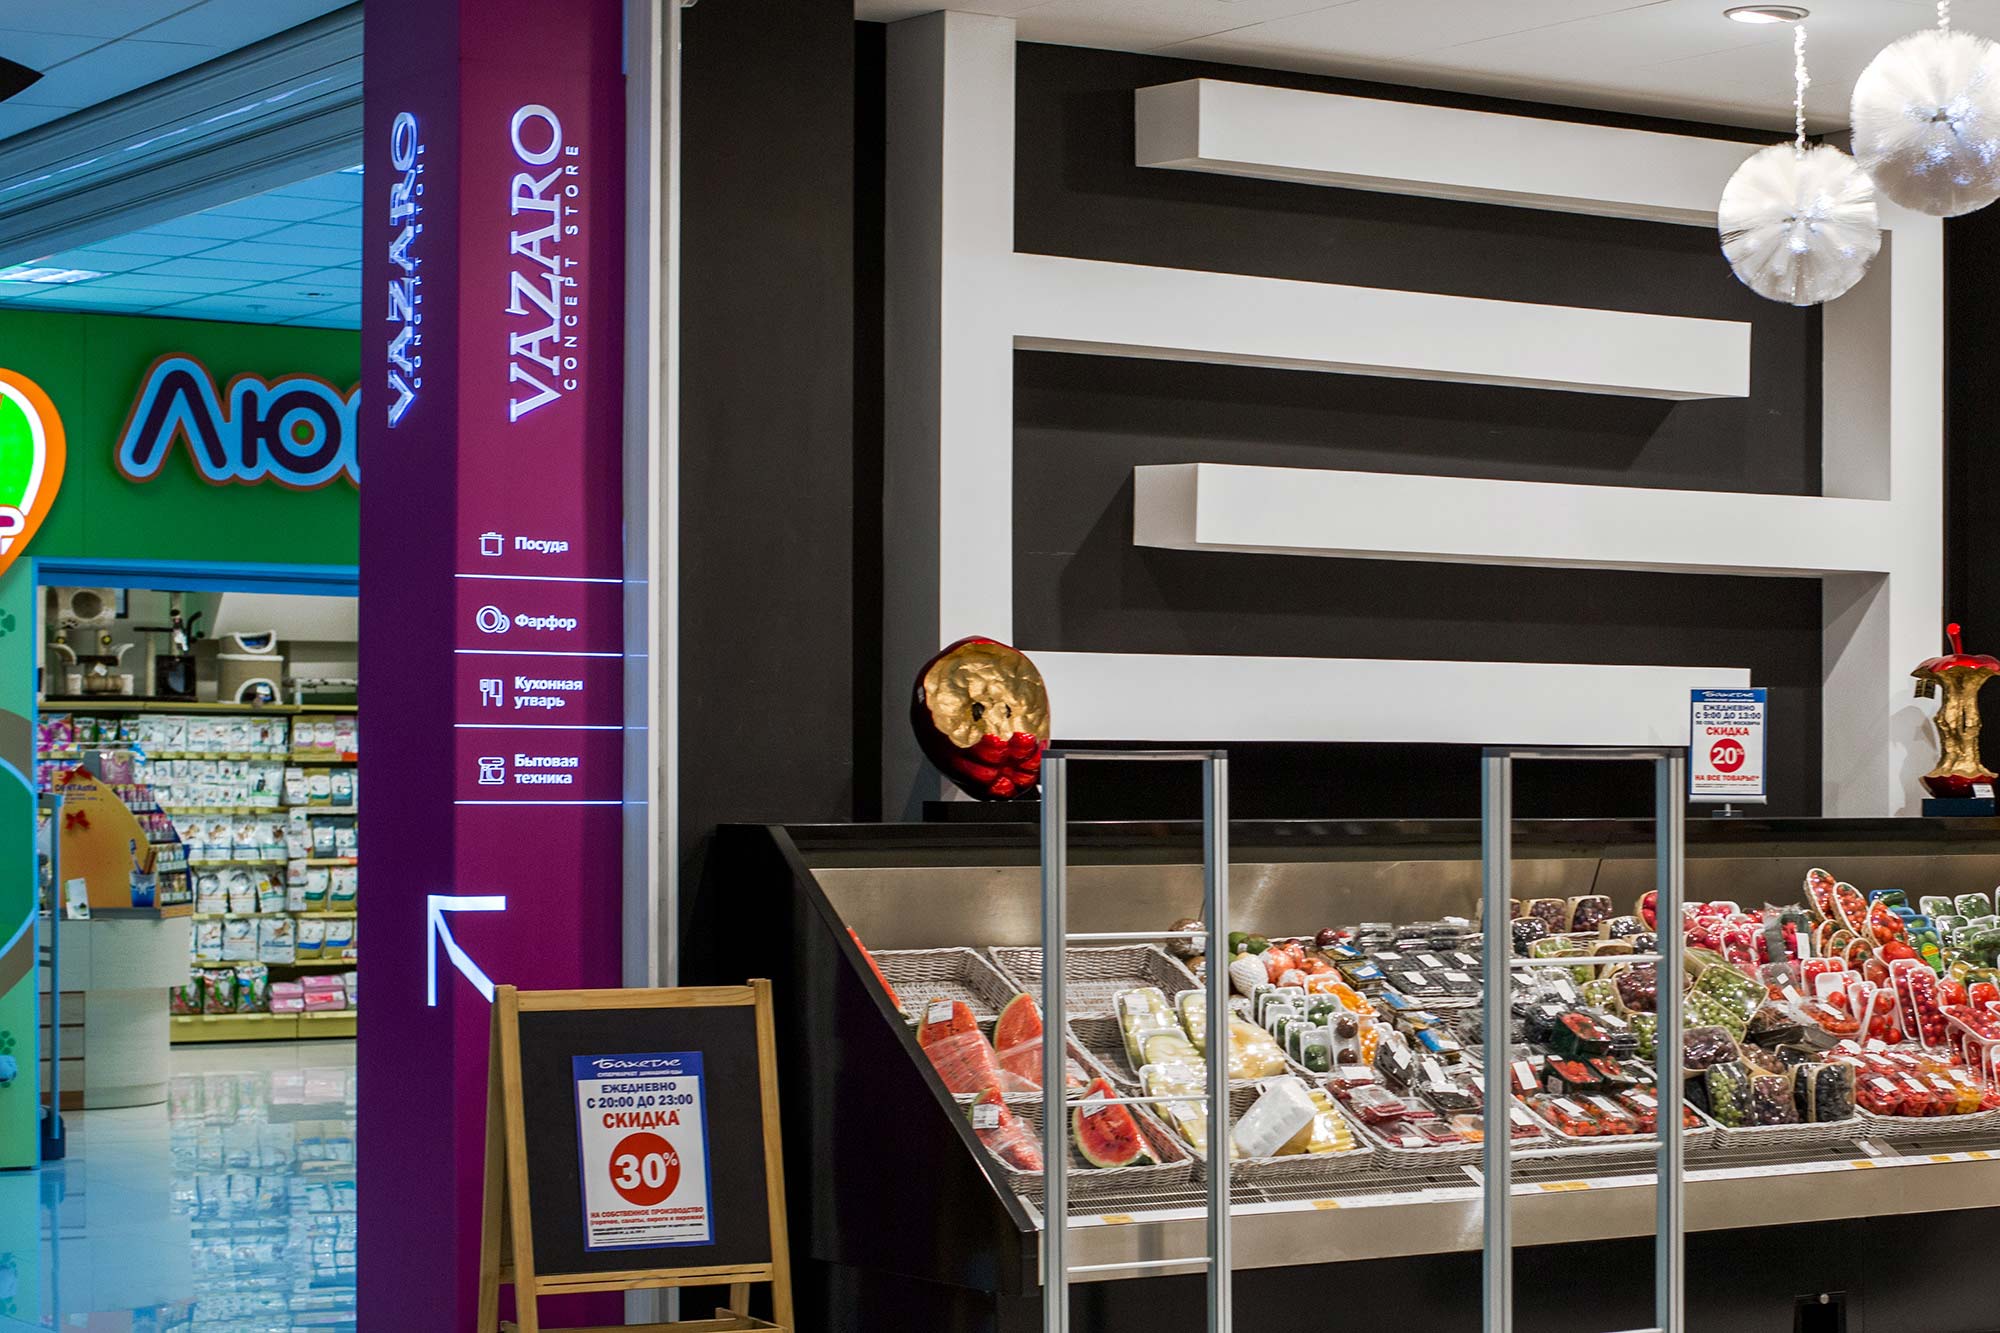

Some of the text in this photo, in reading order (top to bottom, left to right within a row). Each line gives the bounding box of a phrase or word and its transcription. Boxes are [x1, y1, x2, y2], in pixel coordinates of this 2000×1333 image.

[386, 111, 419, 429] VAZARO
[505, 103, 564, 424] VAZARO
[564, 145, 579, 391] CONCEPT STORE
[514, 536, 569, 553] Посуда
[514, 613, 577, 631] Фарфор
[514, 676, 583, 692] Кухонная
[513, 696, 565, 709] утварь
[1695, 711, 1702, 719] С
[1723, 711, 1736, 720] ДО
[1706, 726, 1750, 736] СКИДКА
[514, 753, 578, 767] Бытовая
[514, 773, 573, 784] техника
[592, 1058, 682, 1069] Бахетле
[601, 1081, 677, 1094] ЕЖЕДНЕВНО
[586, 1093, 693, 1109] С 20:00 ДО 23:00
[615, 1152, 678, 1190] 30%
